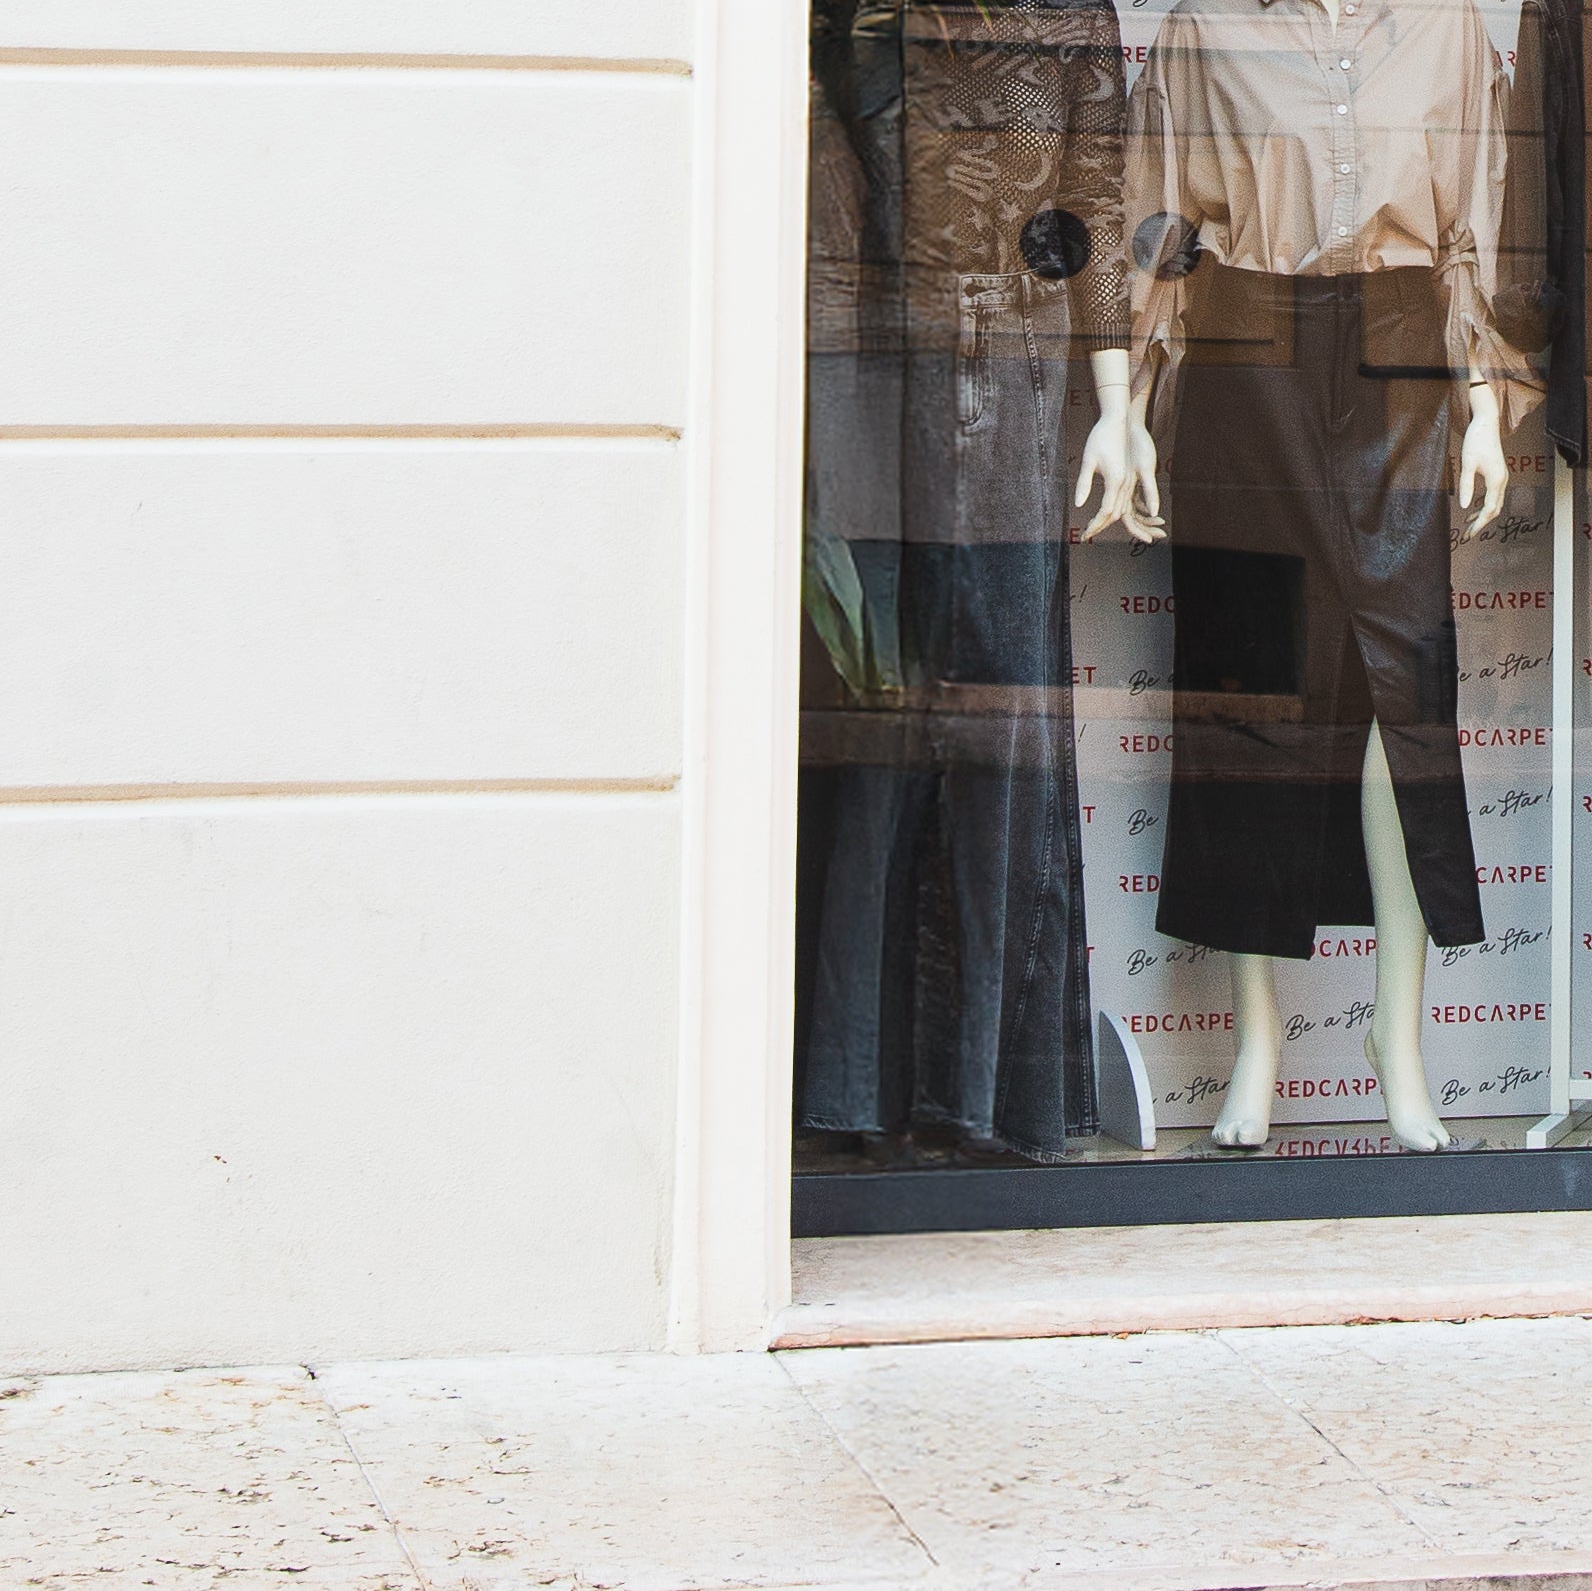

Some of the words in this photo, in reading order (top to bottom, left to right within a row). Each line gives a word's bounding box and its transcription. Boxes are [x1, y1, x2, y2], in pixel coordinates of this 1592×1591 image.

[1479, 530, 1497, 542] a
[1452, 591, 1554, 610] DCARPE
[1458, 670, 1472, 682] e
[1479, 667, 1497, 679] a
[1498, 647, 1554, 680] Star!
[1128, 669, 1160, 696] Be
[1458, 728, 1553, 747] DCARPE
[1479, 804, 1497, 816] a
[1498, 785, 1554, 817] Star!
[1128, 808, 1160, 836] Be
[1476, 865, 1552, 884] CARPE
[1479, 942, 1496, 953] a
[1497, 926, 1553, 956] Star!
[1127, 949, 1159, 976] Be
[1166, 951, 1184, 963] a
[1122, 1013, 1233, 1033] EDCARPE
[1285, 1014, 1317, 1041] Be
[1324, 1016, 1342, 1029] a
[1343, 1001, 1375, 1029] Sta
[1431, 1003, 1551, 1023] REDCARPE
[1165, 1092, 1183, 1104] a
[1184, 1076, 1231, 1104] Star
[1275, 1078, 1377, 1098] REDCARP
[1440, 1079, 1471, 1106] Be
[1479, 1081, 1496, 1093] a
[1497, 1065, 1551, 1095] Star!
